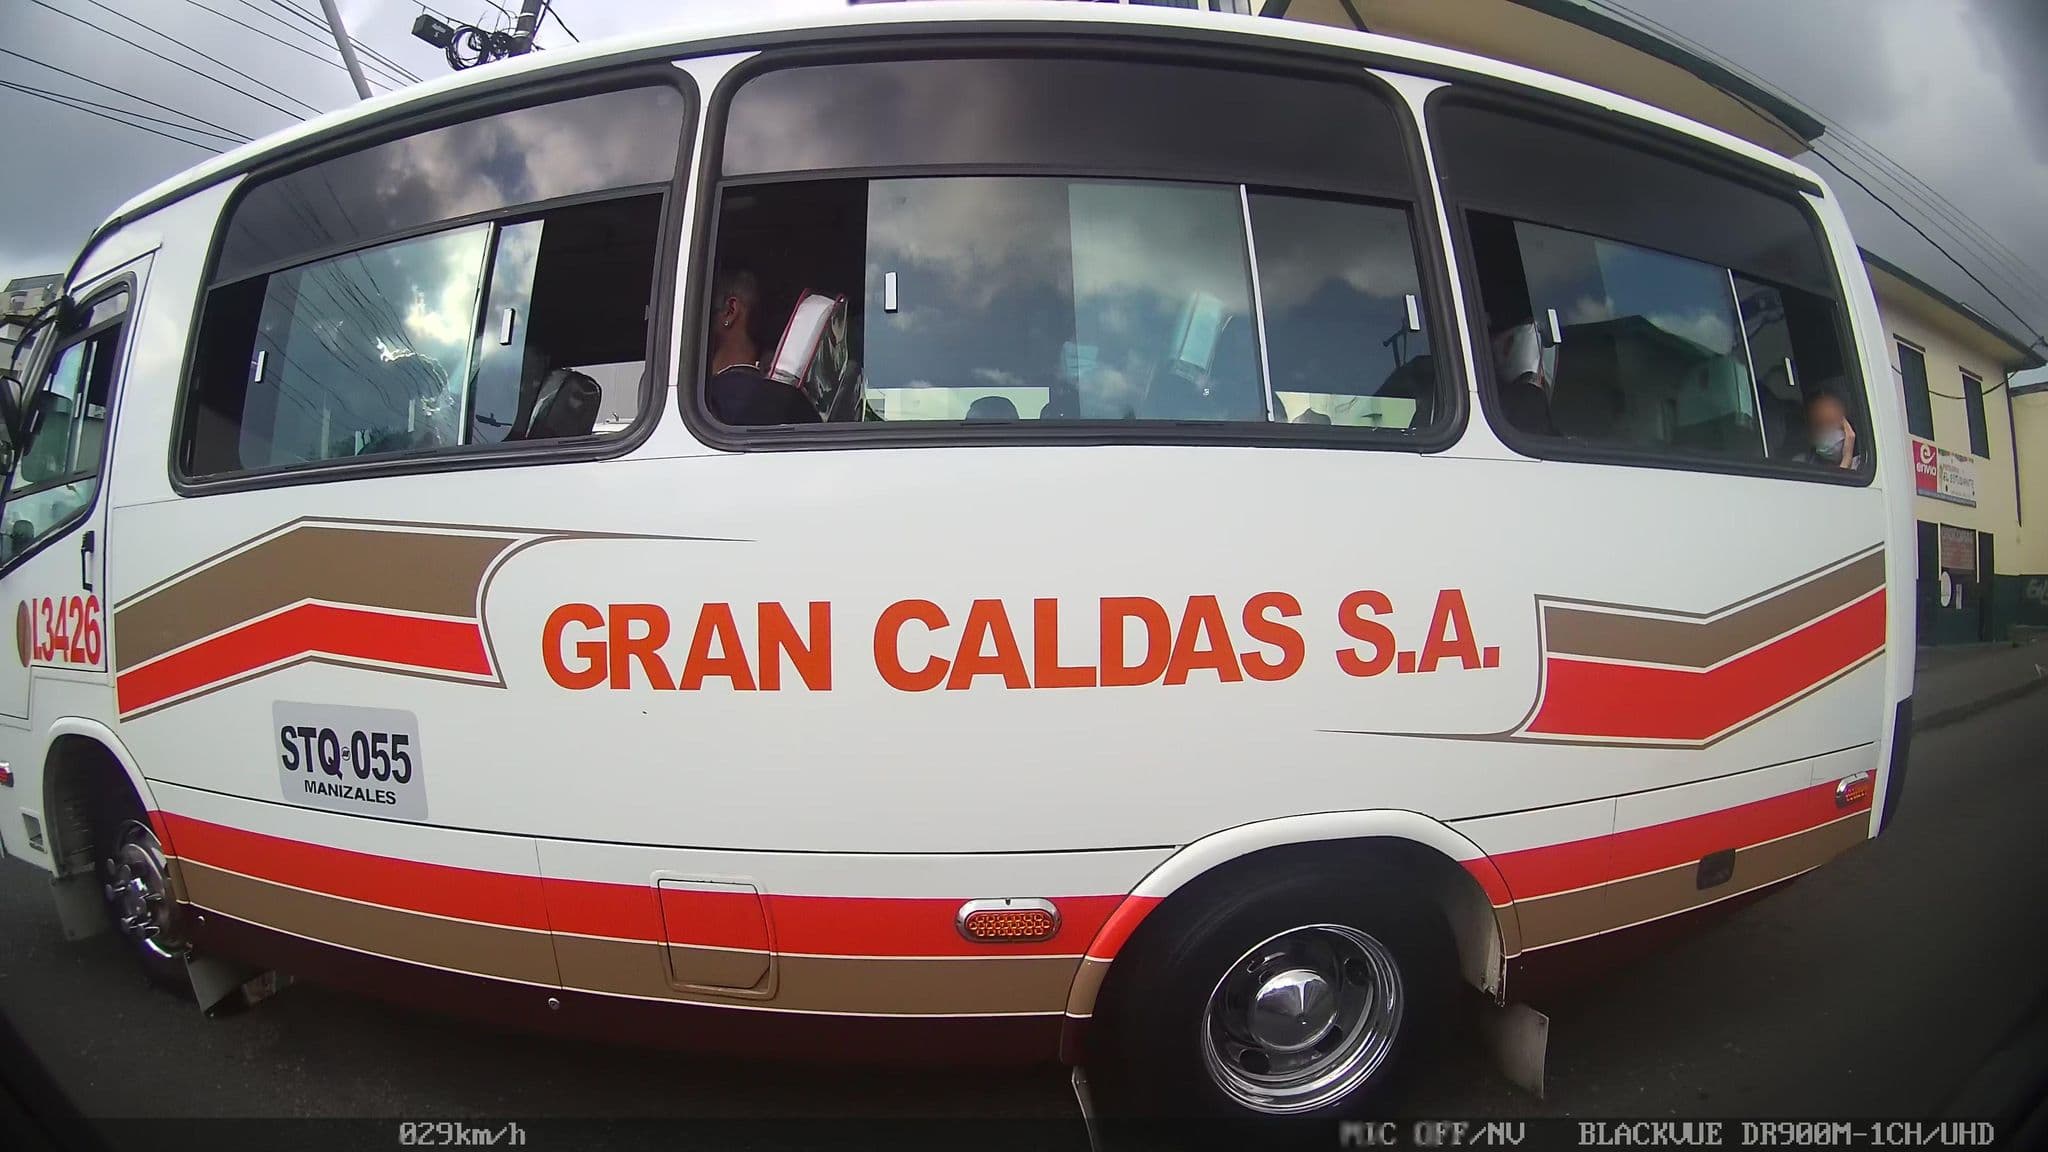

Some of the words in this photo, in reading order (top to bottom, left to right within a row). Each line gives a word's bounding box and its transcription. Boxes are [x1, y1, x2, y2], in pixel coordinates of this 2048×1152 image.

[542, 601, 832, 691] GRAN
[873, 591, 1305, 692] CALDAS
[1336, 588, 1501, 678] S.A.
[304, 780, 396, 805] MANIZALES
